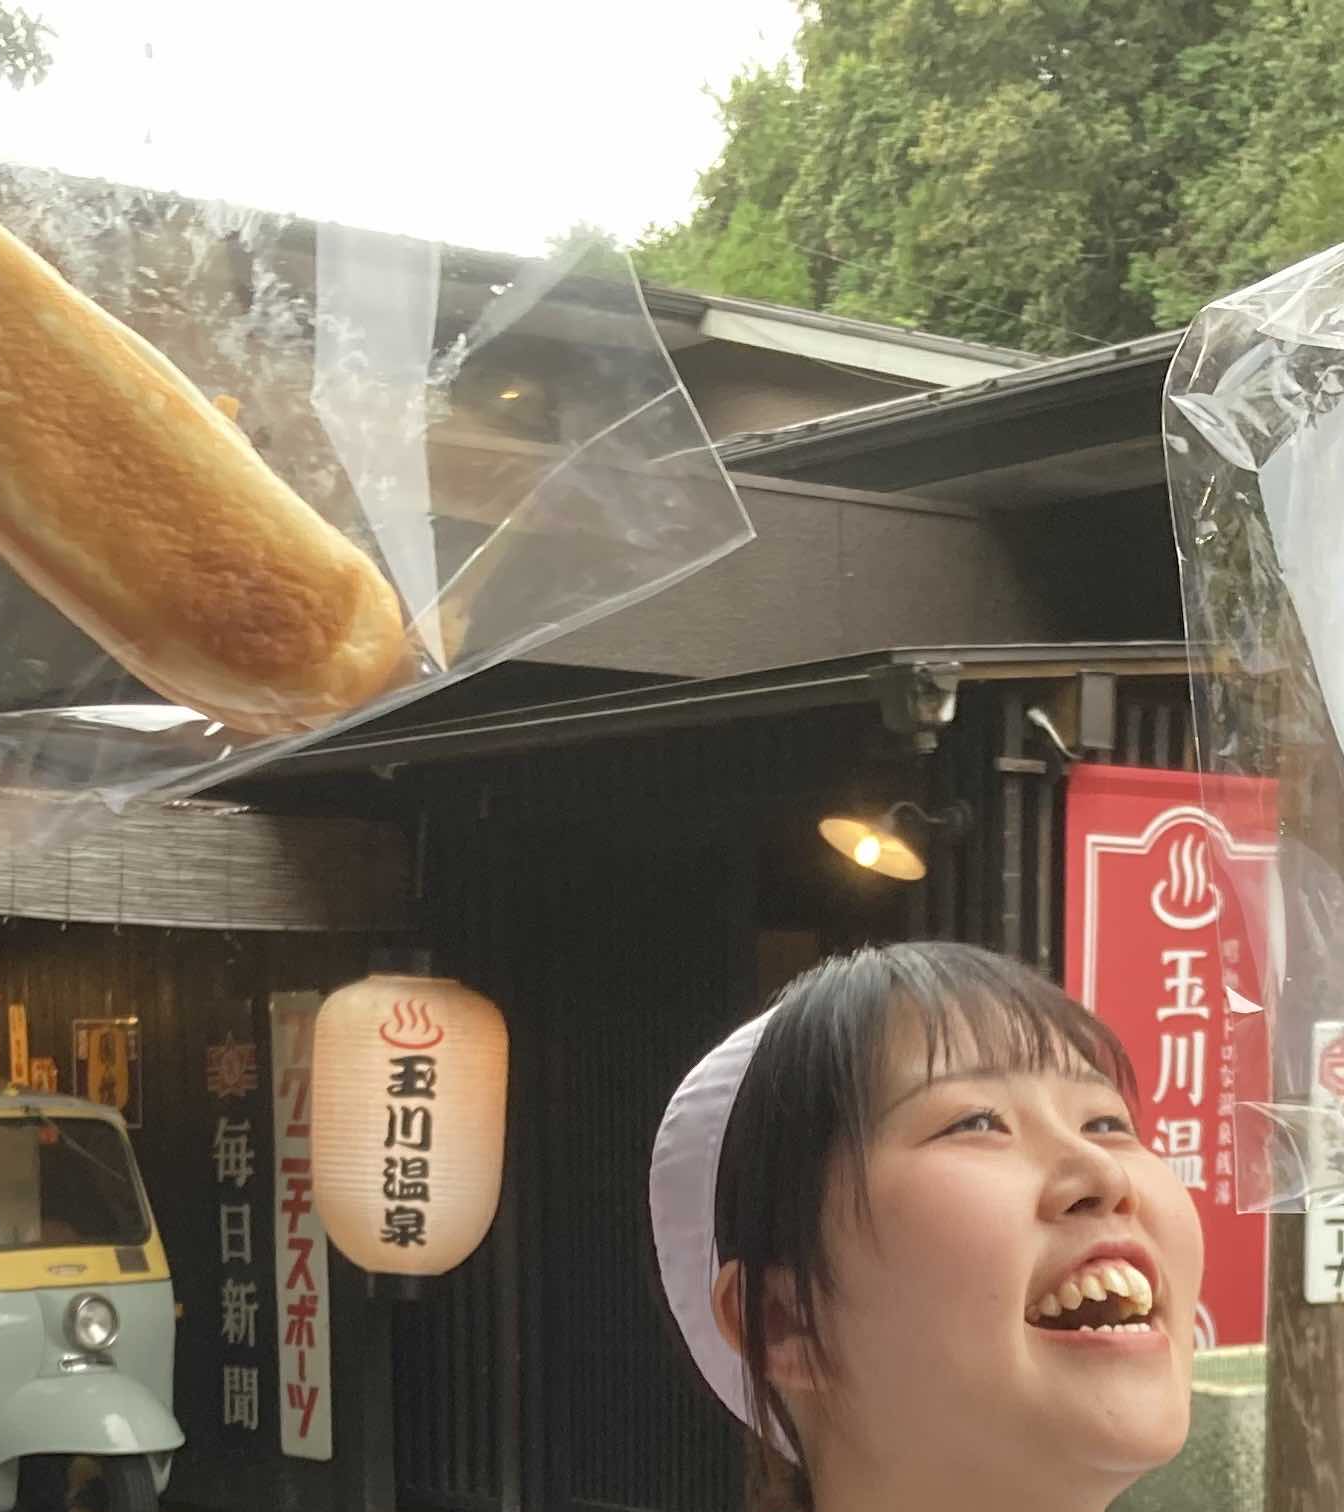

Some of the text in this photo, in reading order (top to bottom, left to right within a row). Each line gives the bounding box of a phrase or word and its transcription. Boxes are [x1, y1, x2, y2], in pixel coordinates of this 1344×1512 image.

[213, 1117, 259, 1430] 毎日新聞
[380, 1055, 437, 1247] 玉川温泉
